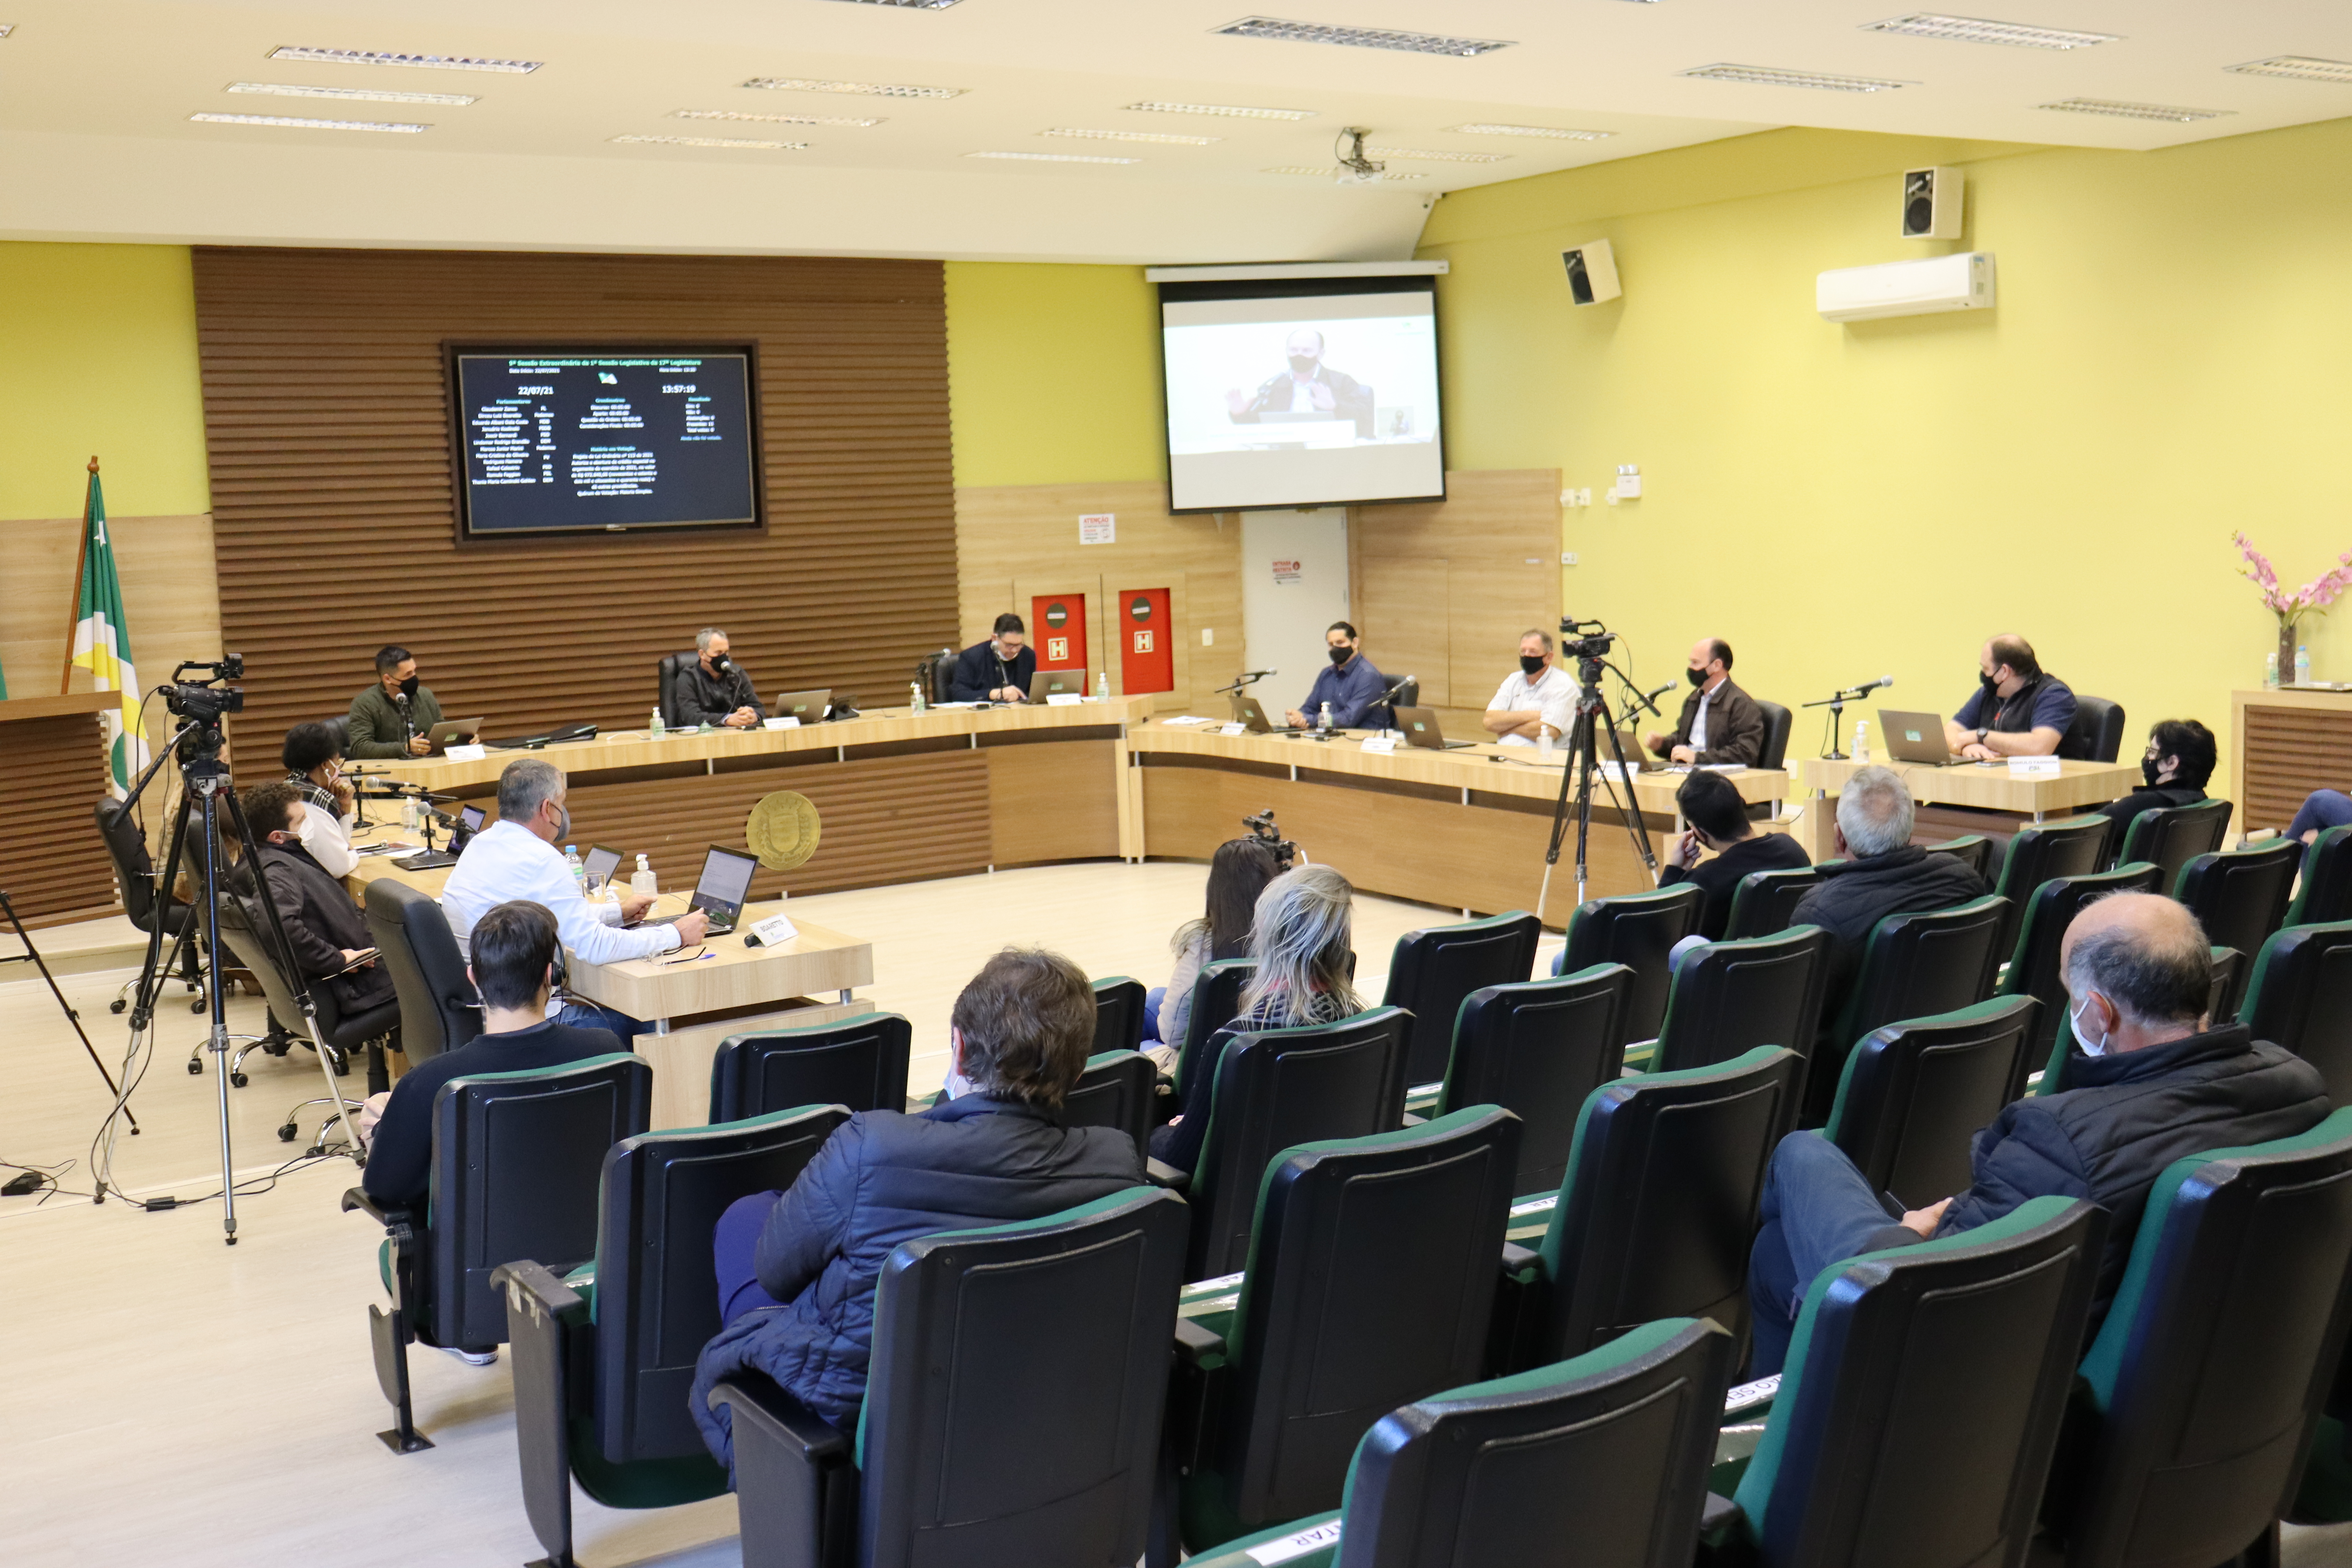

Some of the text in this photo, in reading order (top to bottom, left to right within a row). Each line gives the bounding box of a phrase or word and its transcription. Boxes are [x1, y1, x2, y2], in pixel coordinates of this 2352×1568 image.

[518, 386, 554, 395] 22/07/21
[662, 385, 696, 393] 13:57:19
[1137, 634, 1150, 649] H
[1051, 642, 1064, 657] H
[760, 919, 783, 932] BOARETTO
[1529, 1197, 1557, 1207] TAR
[1291, 1524, 1340, 1546] TAR
